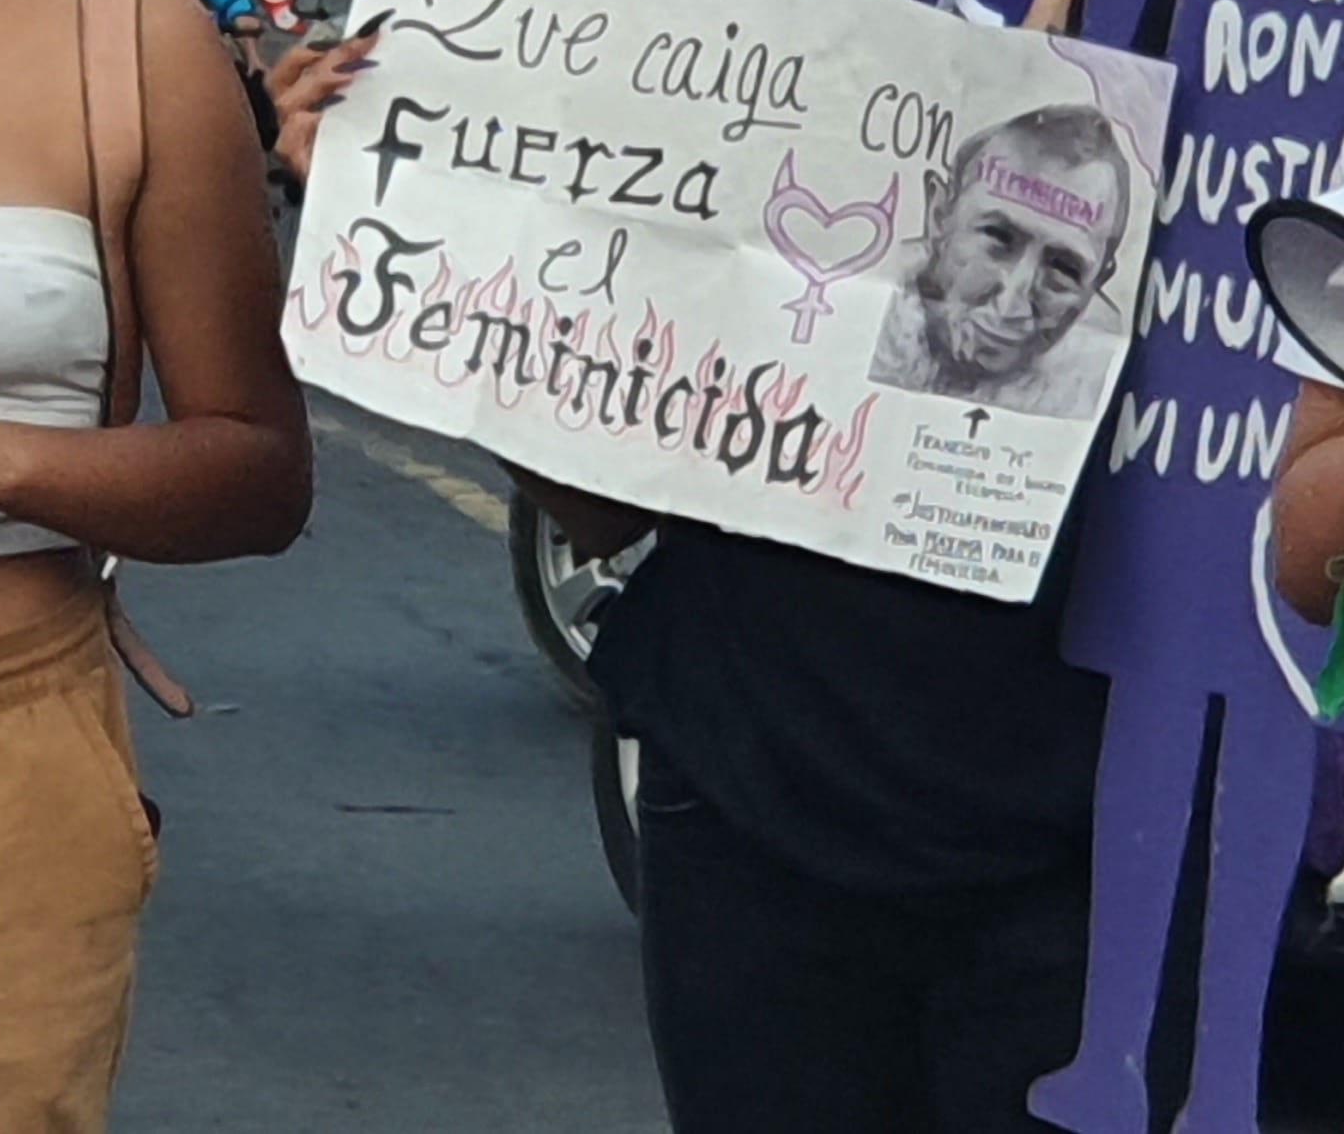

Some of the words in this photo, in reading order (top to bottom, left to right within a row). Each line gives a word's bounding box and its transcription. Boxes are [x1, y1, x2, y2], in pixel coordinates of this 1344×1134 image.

[631, 22, 809, 142] caiga
[860, 83, 955, 170] con
[362, 96, 720, 221] Fuerza
[1158, 133, 1331, 226] JUSTI
[538, 228, 629, 304] el
[1139, 260, 1201, 343] NI
[332, 216, 825, 486] Feminicida
[1109, 391, 1177, 482] NI
